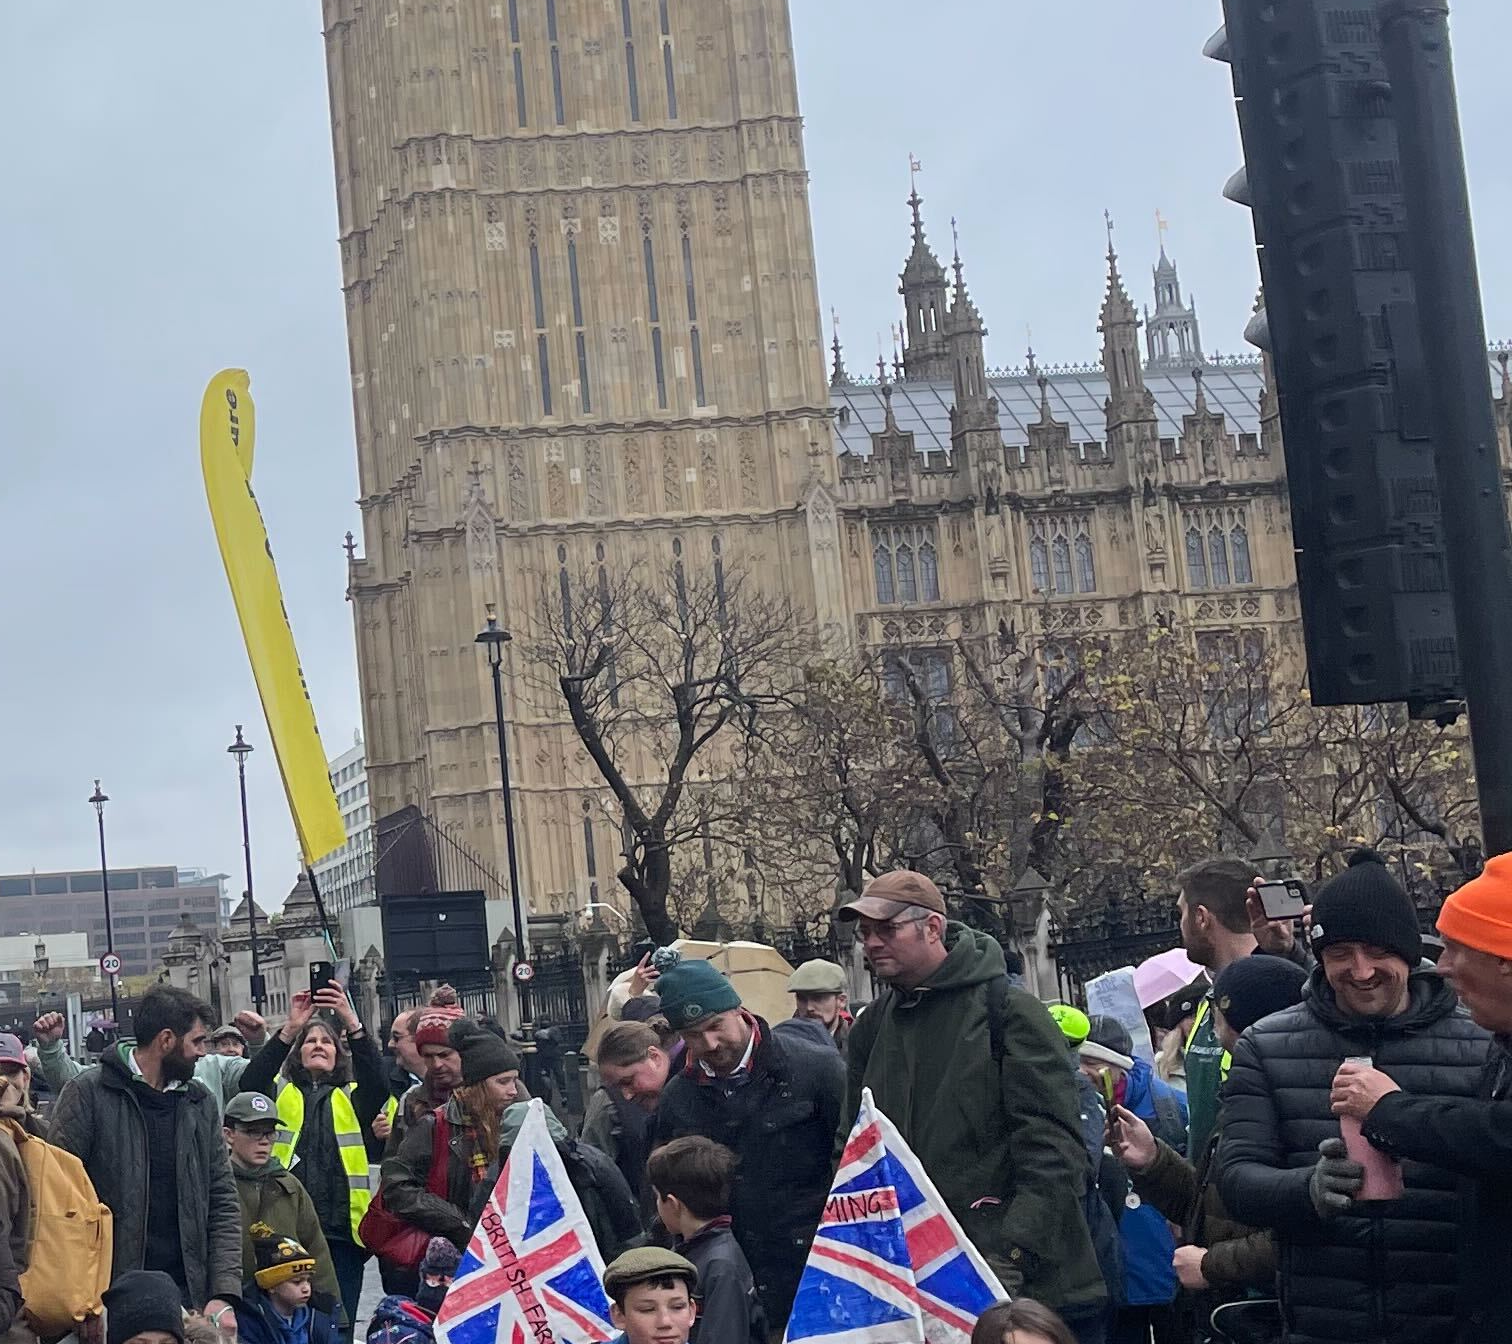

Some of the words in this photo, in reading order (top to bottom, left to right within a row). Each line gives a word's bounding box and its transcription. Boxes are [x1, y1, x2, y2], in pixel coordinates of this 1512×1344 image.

[104, 959, 119, 968] 20
[517, 967, 531, 976] 20
[481, 1212, 533, 1296] BRITISH
